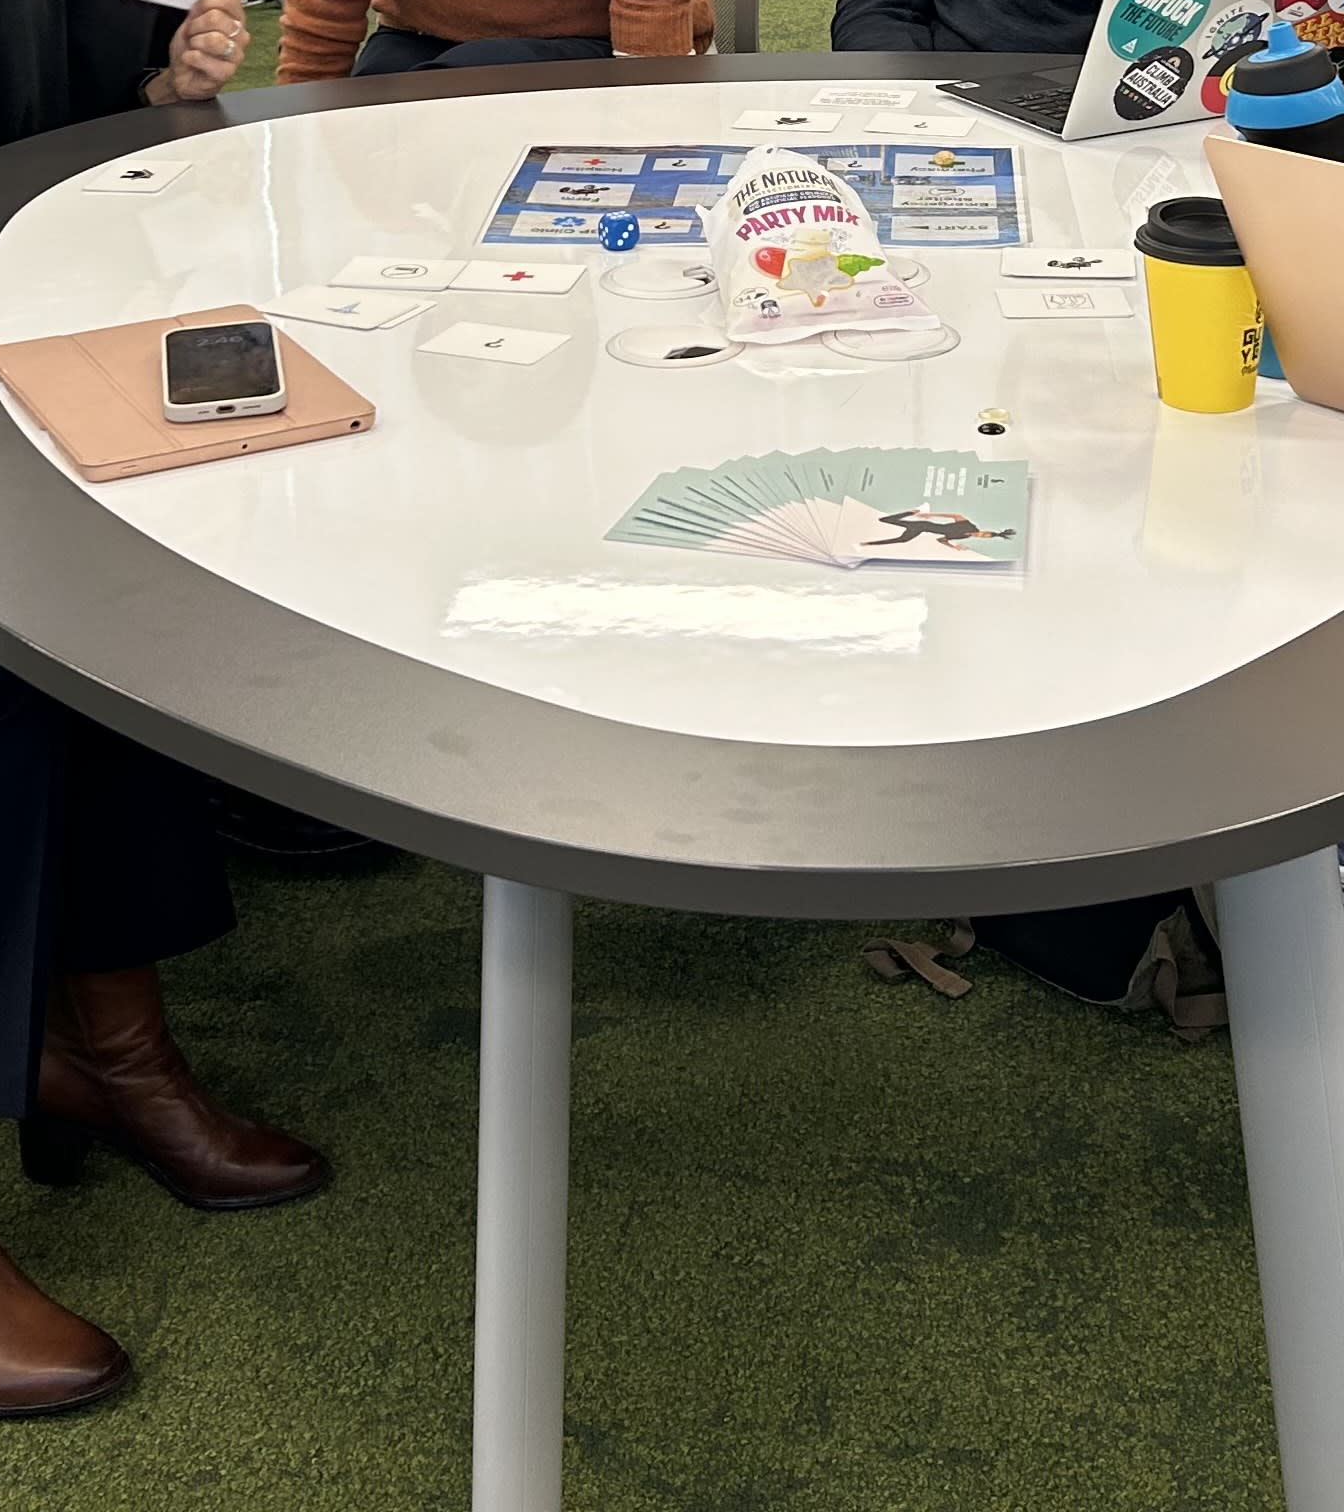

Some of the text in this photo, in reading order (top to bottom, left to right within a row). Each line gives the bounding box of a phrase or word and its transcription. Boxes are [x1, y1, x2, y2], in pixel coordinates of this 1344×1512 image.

[1119, 3, 1184, 42] THE FUTURE
[1205, 5, 1245, 39] IGNITE
[1126, 71, 1174, 107] AUSTRALIA
[1145, 64, 1174, 87] CLIMB
[909, 166, 986, 174] Pharmacy
[732, 179, 758, 208] THE
[900, 200, 990, 208] Emergency
[735, 206, 806, 242] PARTY
[934, 224, 989, 232] START
